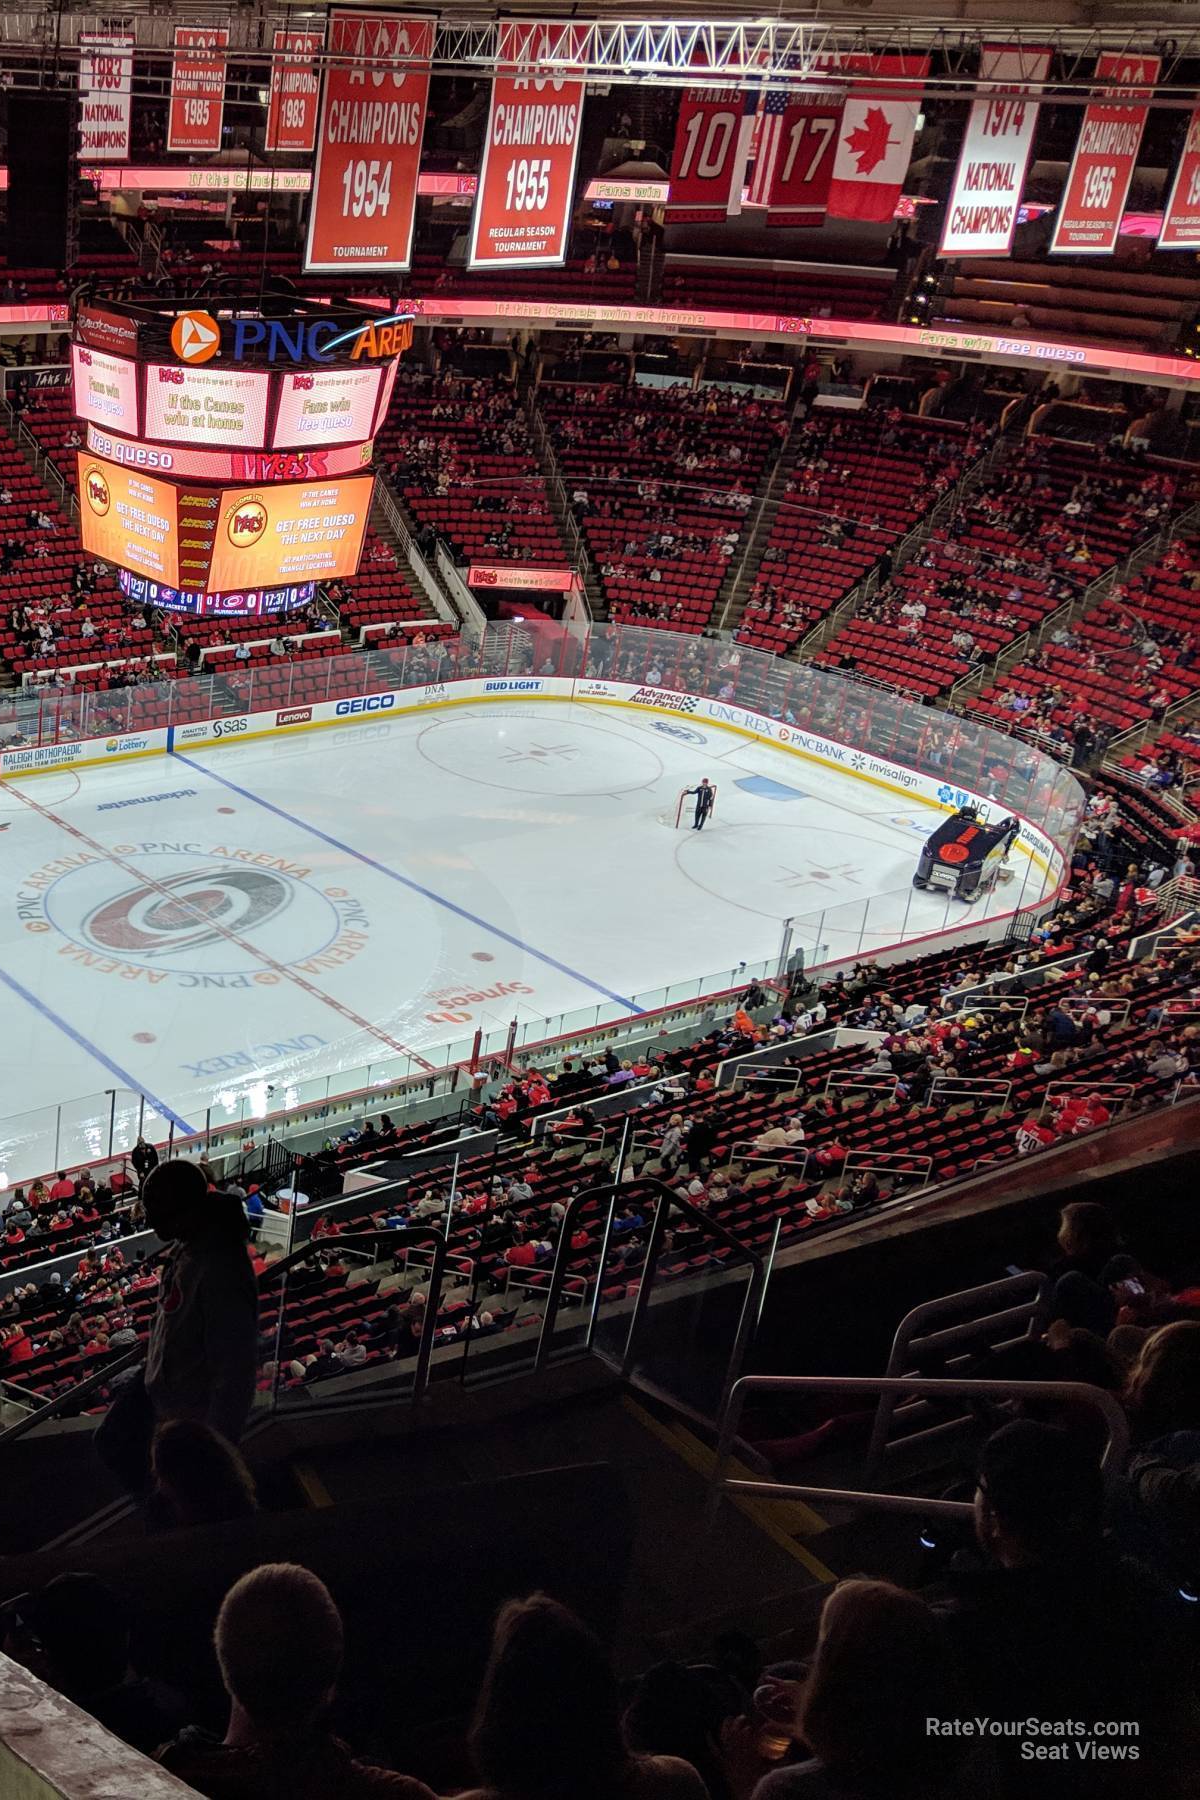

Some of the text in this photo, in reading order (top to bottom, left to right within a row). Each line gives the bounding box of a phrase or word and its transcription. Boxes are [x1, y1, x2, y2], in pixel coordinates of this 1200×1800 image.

[175, 70, 224, 93] CHAMPIONS
[274, 72, 318, 94] CHAMPIONS
[84, 104, 124, 122] NATIONAL
[183, 99, 210, 126] 1985
[281, 99, 305, 128] 1983
[983, 83, 1029, 137] 1974
[327, 100, 420, 146] CHAMPIONS
[493, 104, 576, 146] CHAMPIONS
[81, 131, 126, 149] CHAMPIONS
[678, 111, 737, 179] 10
[1081, 121, 1141, 155] CHAMPIONS
[781, 117, 836, 183] 17
[206, 173, 230, 187] the
[505, 159, 551, 211] 1955
[963, 162, 1017, 191] NATIONAL
[1081, 165, 1117, 210] 1956
[342, 160, 393, 218] 1954
[596, 184, 662, 199] Fans win
[950, 205, 1013, 234] CHAMPIONS
[489, 225, 555, 239] REGULAR SEASON
[333, 246, 388, 258] TOURNAMENT
[494, 240, 547, 252] TOURNAMENT
[546, 304, 598, 320] Canes
[601, 306, 632, 322] win
[231, 320, 339, 362] PNC
[919, 331, 1087, 363] Fans win free queso
[34, 369, 62, 387] TAKE
[180, 394, 245, 414] the Canes
[302, 396, 351, 415] Fans win
[164, 410, 243, 430] win at home
[297, 415, 353, 432] free queso
[91, 432, 173, 469] free queso
[116, 501, 129, 515] GET
[130, 506, 146, 522] FREE
[147, 513, 170, 532] QUESO
[224, 493, 264, 520] WELCOME TO
[121, 517, 134, 531] THE
[134, 522, 151, 539] NEXT
[151, 529, 165, 545] DAY
[275, 513, 355, 533] GET FREE QUESO
[281, 528, 346, 545] THE NEXT DAY
[265, 592, 285, 606] 17:37
[424, 685, 446, 695] DNA
[485, 680, 542, 691] BUD LIGHT
[636, 688, 682, 703] Advance
[335, 694, 395, 715] GEICO
[628, 694, 679, 710] Auto Parts
[278, 711, 310, 723] Lenovo
[708, 703, 774, 736] UNC REX
[182, 725, 208, 735] ANALYTICS
[3, 743, 82, 766] RALEIGH ORTHOPAEDIC
[118, 738, 148, 752] Lottery
[10, 762, 33, 771] OFFICIAL
[50, 756, 74, 765] DOCTORS
[869, 760, 918, 787] invisalign
[96, 789, 199, 812] ticketmaster
[139, 842, 313, 880] PNC ARENA
[16, 852, 99, 921] PNC ARENA
[292, 897, 370, 976] PNC ARENA
[57, 943, 255, 989] PNC ARENA
[178, 1033, 330, 1078] UNC REX
[1021, 1133, 1038, 1151] 20
